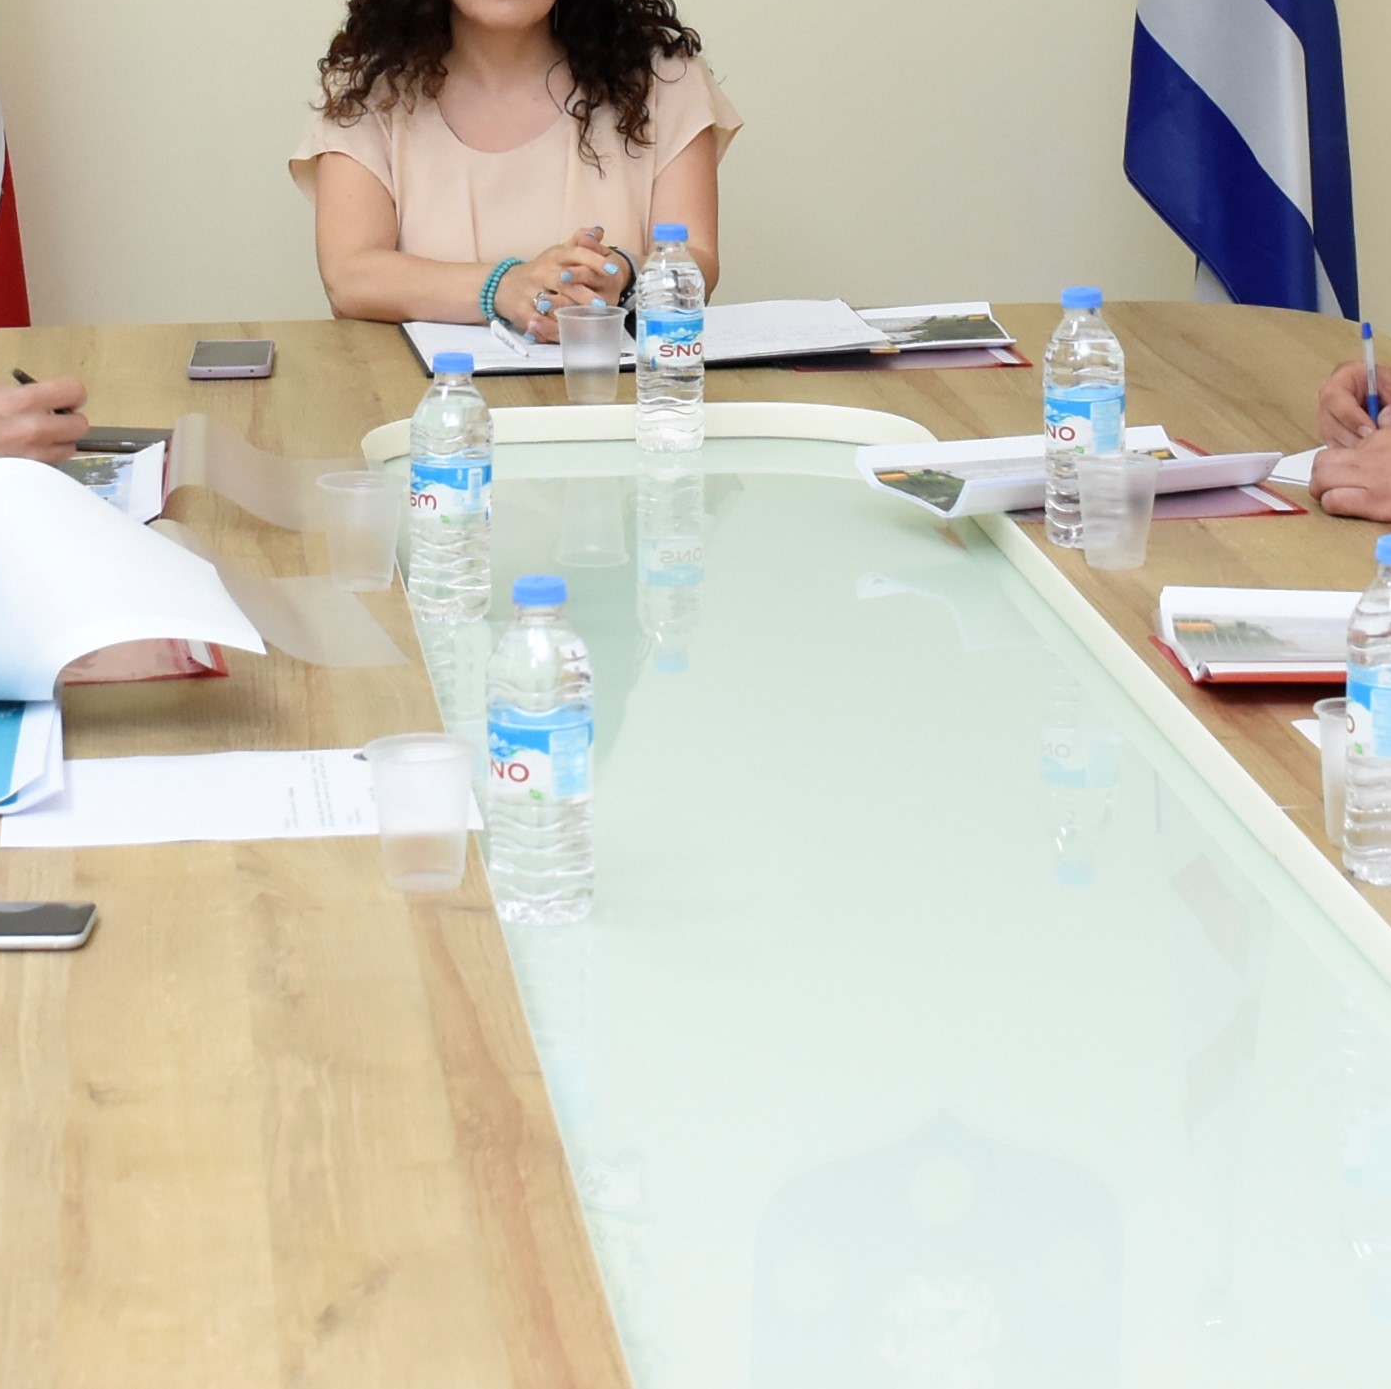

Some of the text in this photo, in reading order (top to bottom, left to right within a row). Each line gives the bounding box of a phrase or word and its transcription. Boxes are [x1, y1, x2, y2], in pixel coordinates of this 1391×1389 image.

[659, 342, 702, 357] SNO
[1046, 423, 1075, 441] NO
[491, 758, 530, 782] NO
